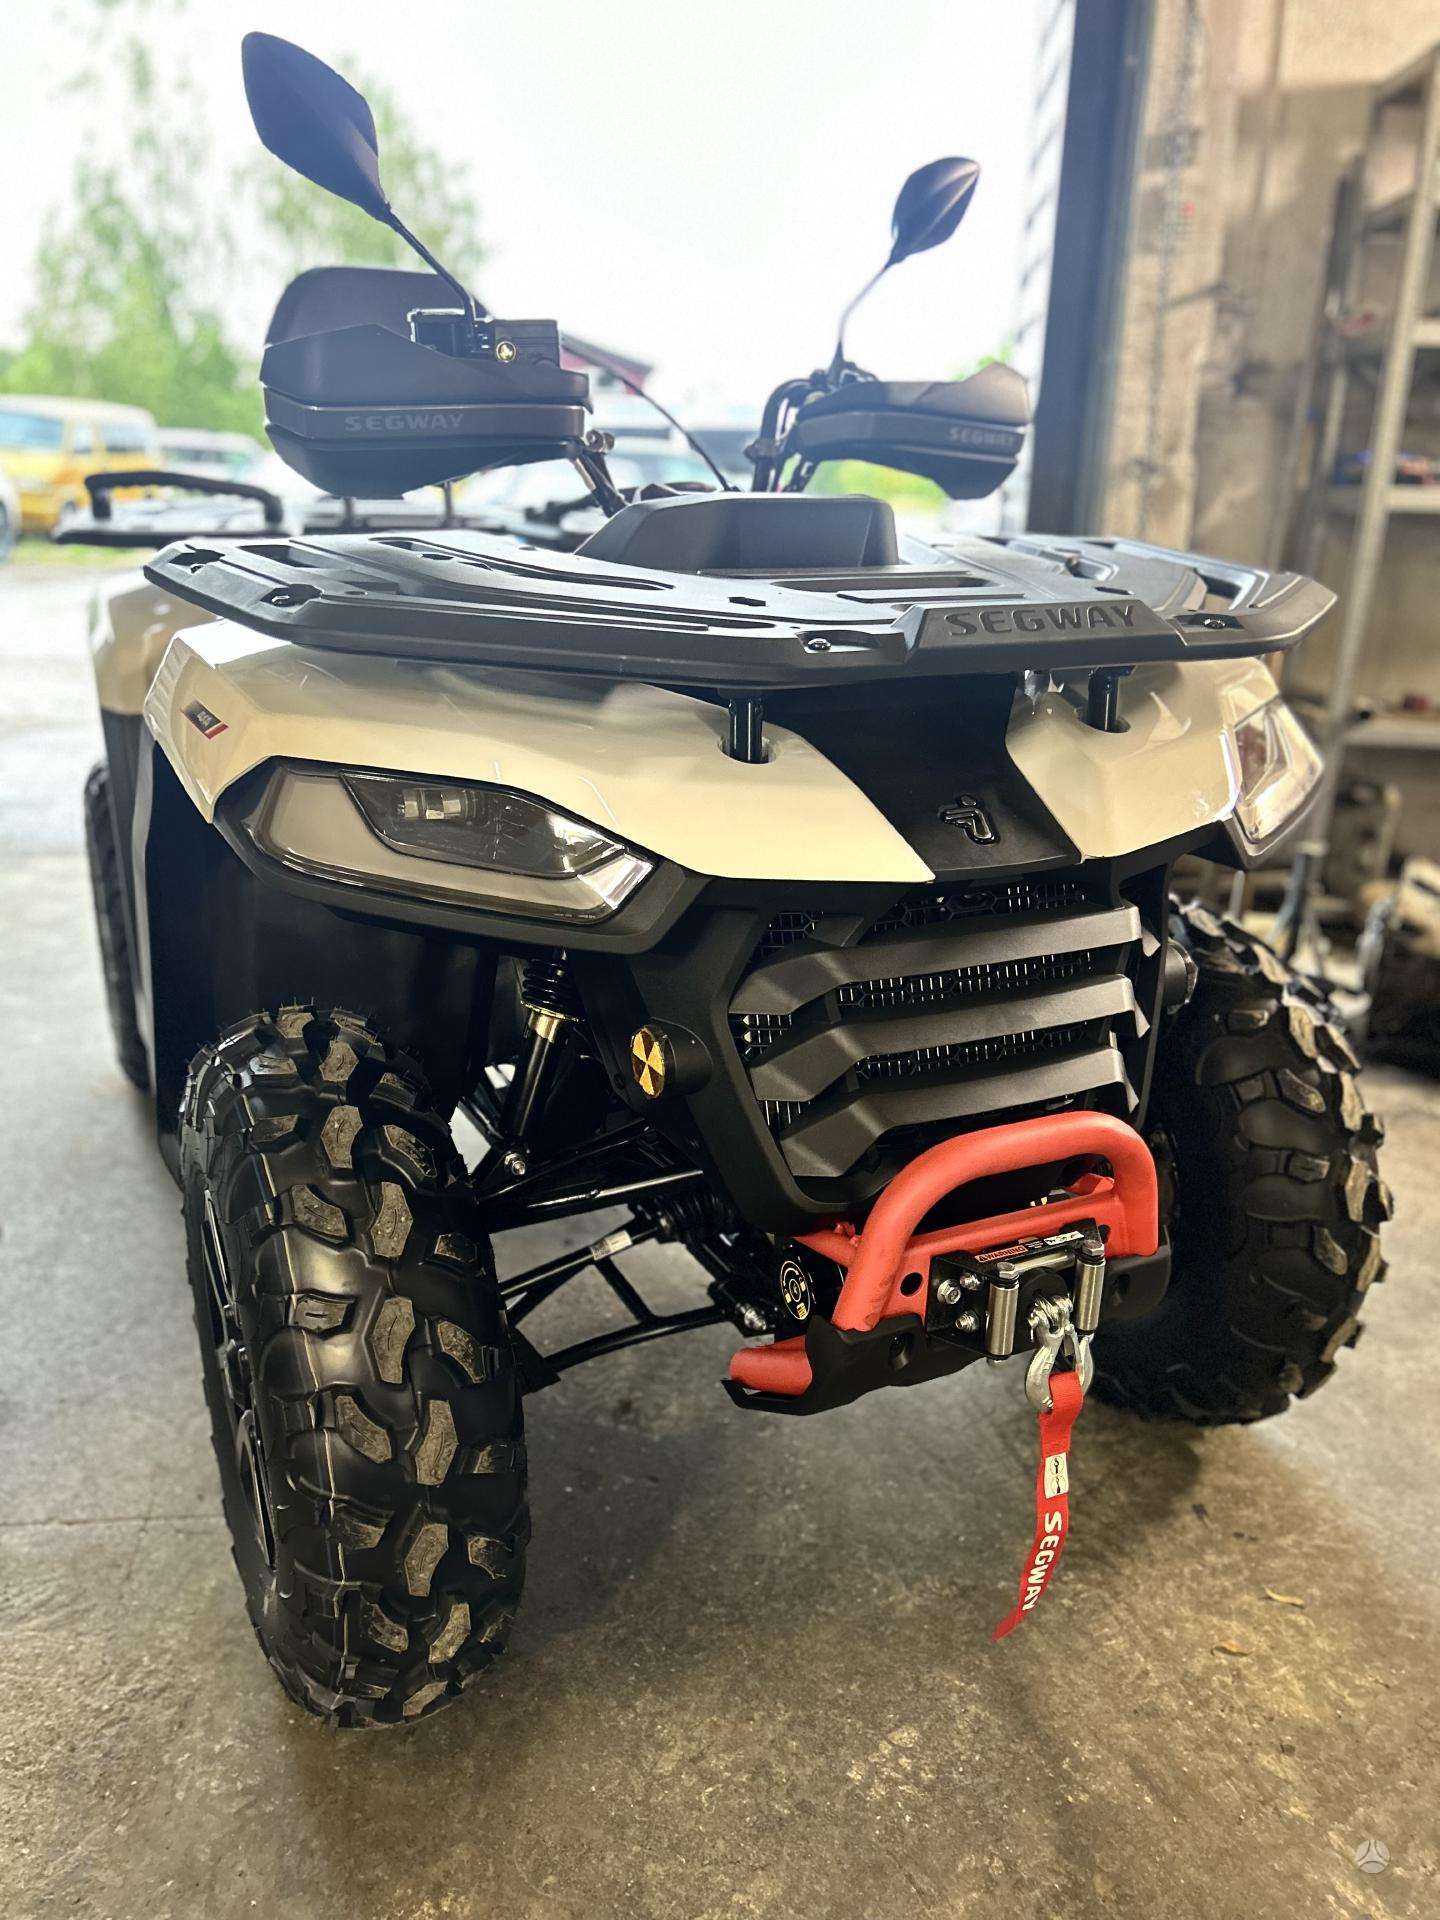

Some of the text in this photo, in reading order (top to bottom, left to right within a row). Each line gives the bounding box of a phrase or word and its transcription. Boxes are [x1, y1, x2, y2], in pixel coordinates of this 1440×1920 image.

[344, 413, 464, 431] SEGWAY
[944, 604, 1135, 636] SEGWAY
[1022, 1511, 1062, 1611] SEGWAY
